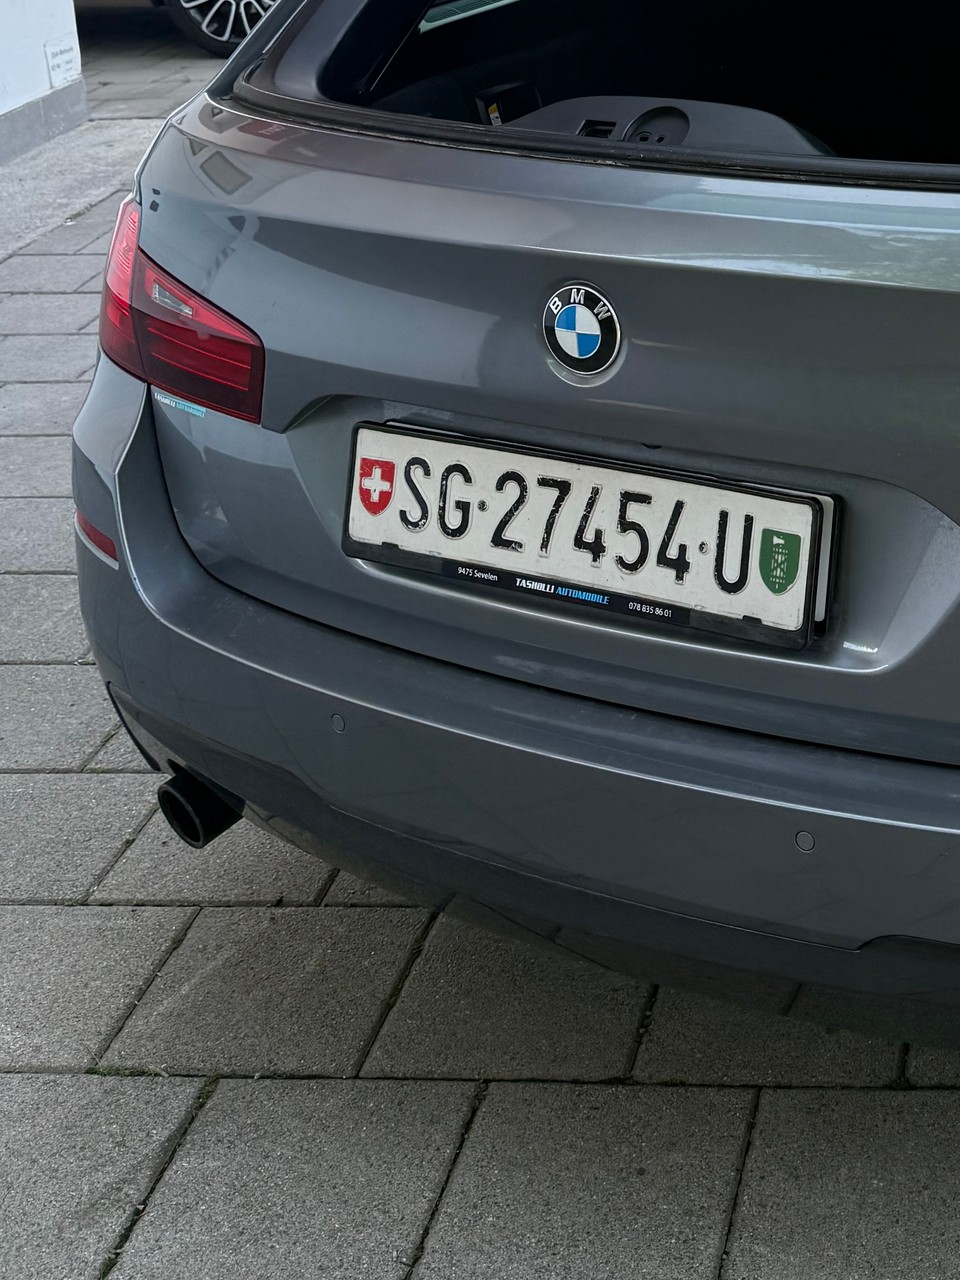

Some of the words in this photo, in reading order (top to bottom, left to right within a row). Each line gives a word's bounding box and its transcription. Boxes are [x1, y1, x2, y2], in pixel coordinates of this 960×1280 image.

[549, 289, 611, 321] BMW
[399, 456, 473, 538] SG
[489, 470, 691, 585] 27454
[713, 509, 754, 595] U
[457, 566, 473, 577] 9475
[473, 569, 498, 582] Sevelen
[516, 577, 555, 594] TASHOLLI
[555, 586, 610, 605] AUTOMOBILE
[628, 601, 641, 612] 078
[654, 607, 664, 617] 86
[663, 608, 672, 618] 01
